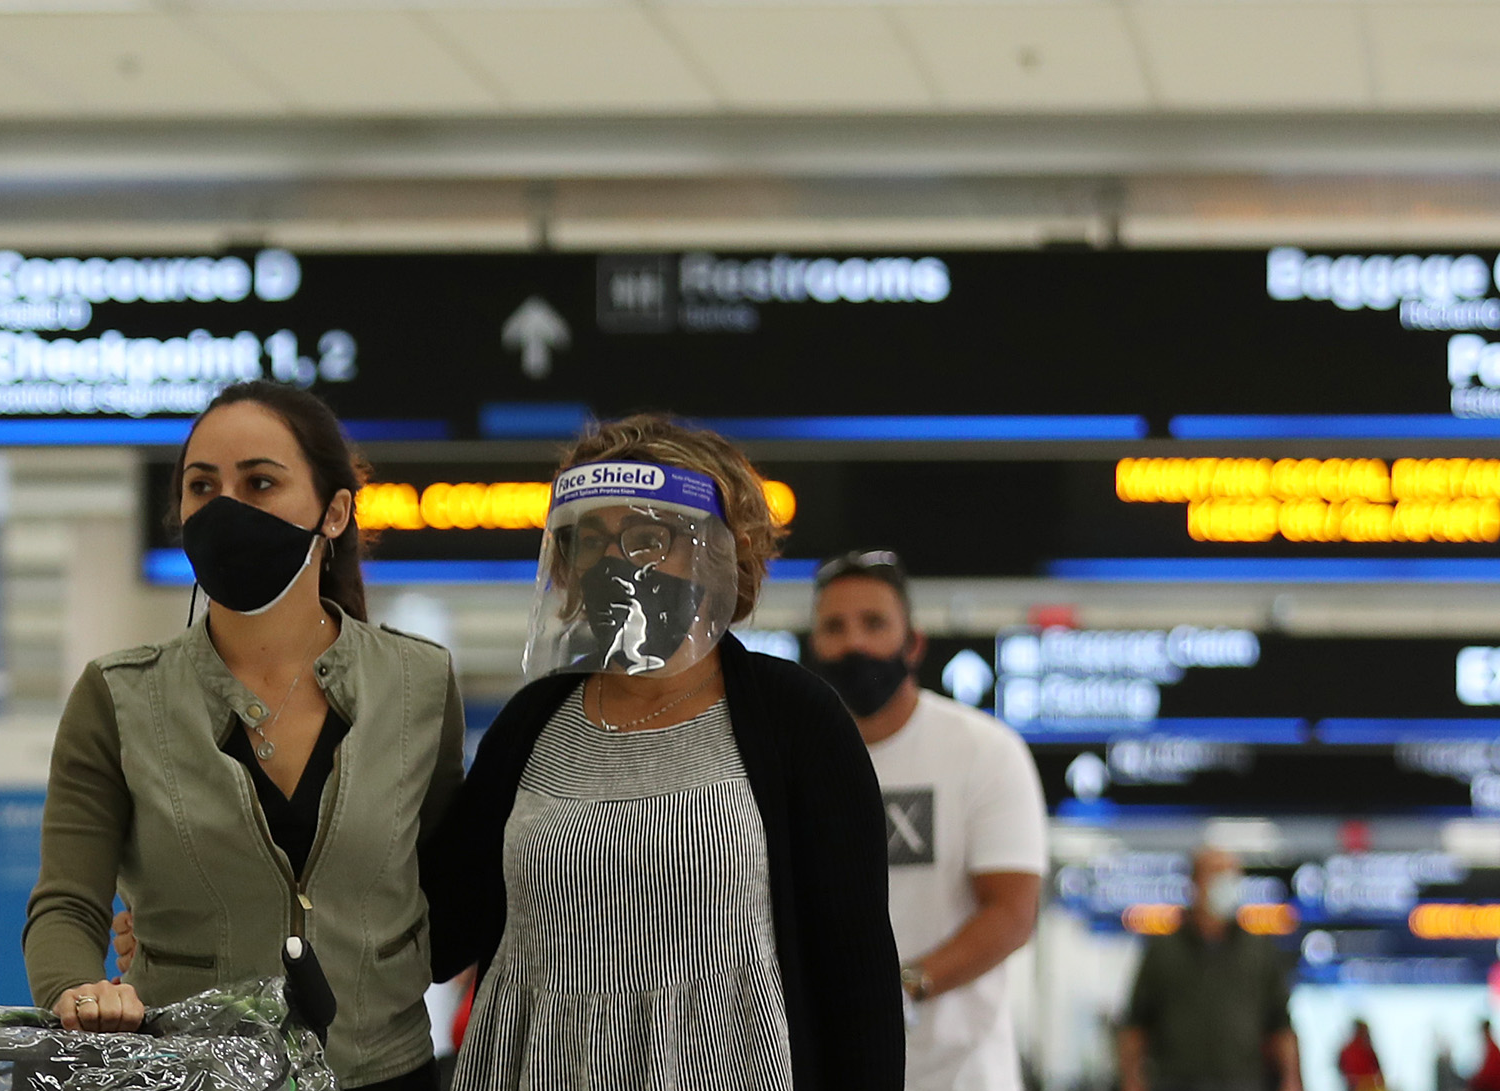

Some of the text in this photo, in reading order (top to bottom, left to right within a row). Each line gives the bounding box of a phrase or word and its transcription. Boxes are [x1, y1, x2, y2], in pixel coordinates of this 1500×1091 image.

[680, 252, 950, 303] Restrooms
[1266, 247, 1490, 311] Baggage
[591, 467, 656, 486] Shield
[599, 487, 636, 496] Protection
